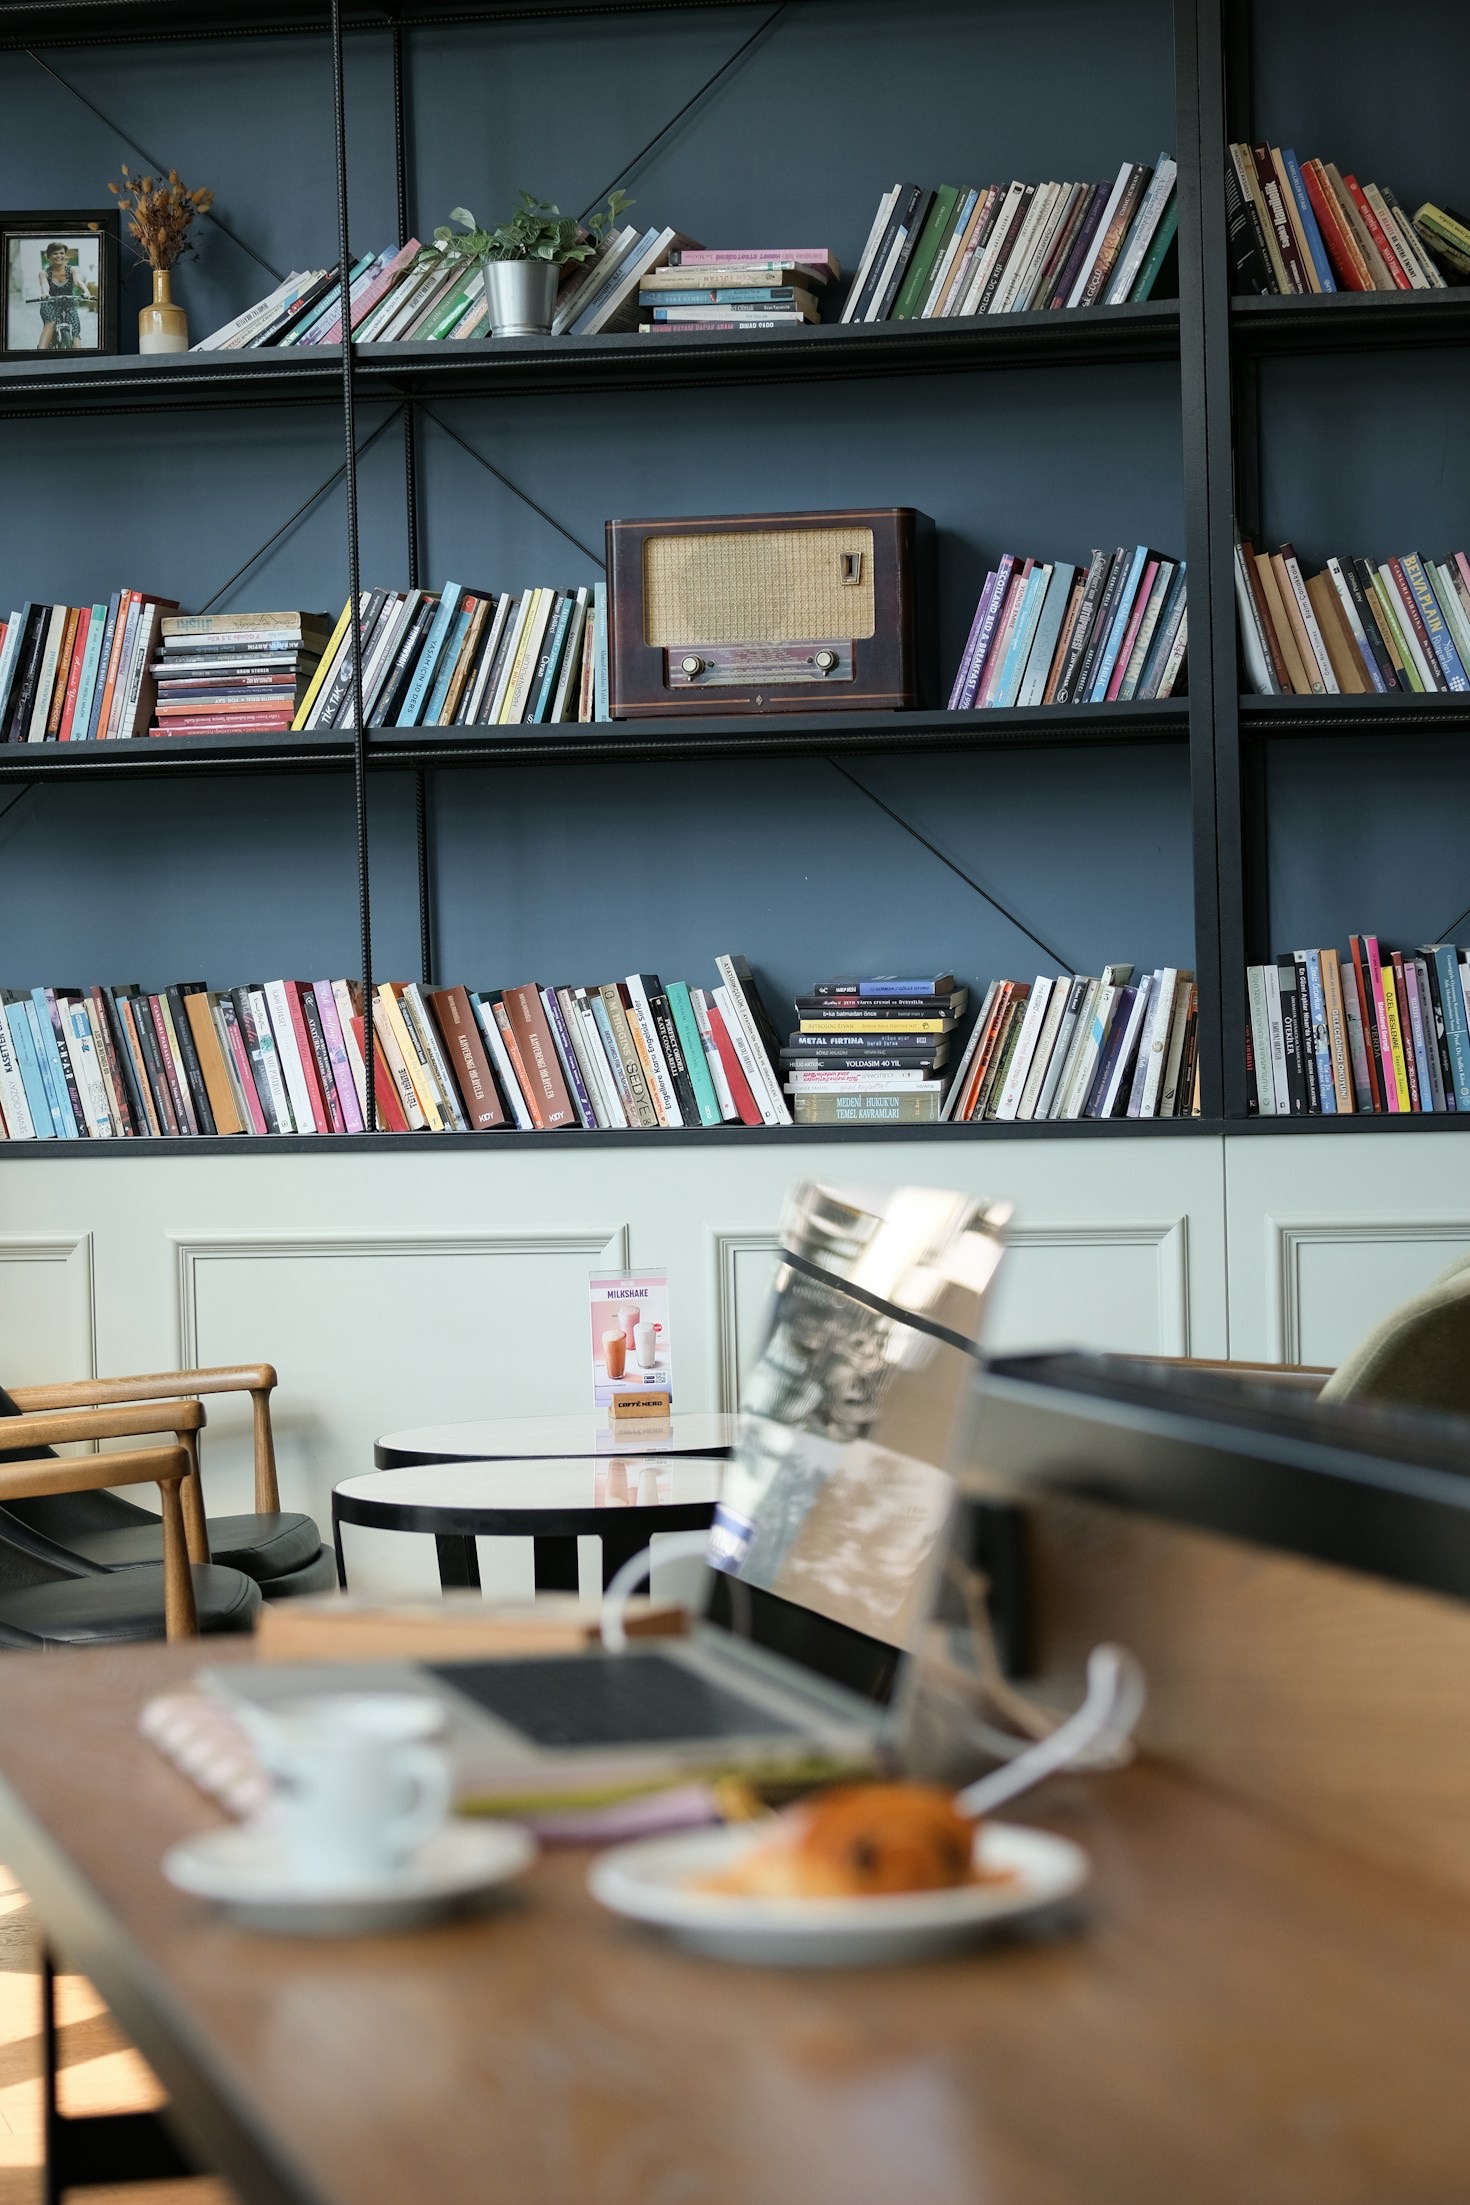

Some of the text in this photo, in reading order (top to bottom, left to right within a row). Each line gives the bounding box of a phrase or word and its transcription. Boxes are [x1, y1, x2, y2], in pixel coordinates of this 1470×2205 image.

[977, 289, 992, 315] YOLDA
[987, 568, 1007, 614] SCOTLAND
[1014, 584, 1025, 608] YUNUS
[1403, 553, 1443, 633] BELVA PLAIN
[983, 615, 994, 631] BED
[1008, 609, 1018, 629] EMRE
[967, 642, 986, 689] BREAKFAST
[318, 684, 344, 724] TİK TAK
[656, 1015, 667, 1034] KATE
[1298, 967, 1313, 1054] En Güzel Aşklar Nisan'da Yanar
[1385, 991, 1399, 1049] ÖZEL BESLENME
[798, 1036, 864, 1046] METAL FIRTINA
[1283, 1016, 1295, 1054] ÖTEKİLER
[1331, 1009, 1343, 1063] GELECEĞİNİZİ
[1337, 1064, 1347, 1098] OKUYUN!
[625, 1062, 650, 1117] SEDYE
[840, 1095, 864, 1108] MEDENİ
[839, 1108, 900, 1118] TEMEL KAVRAMLARI
[608, 1289, 648, 1299] MILKSHAKE
